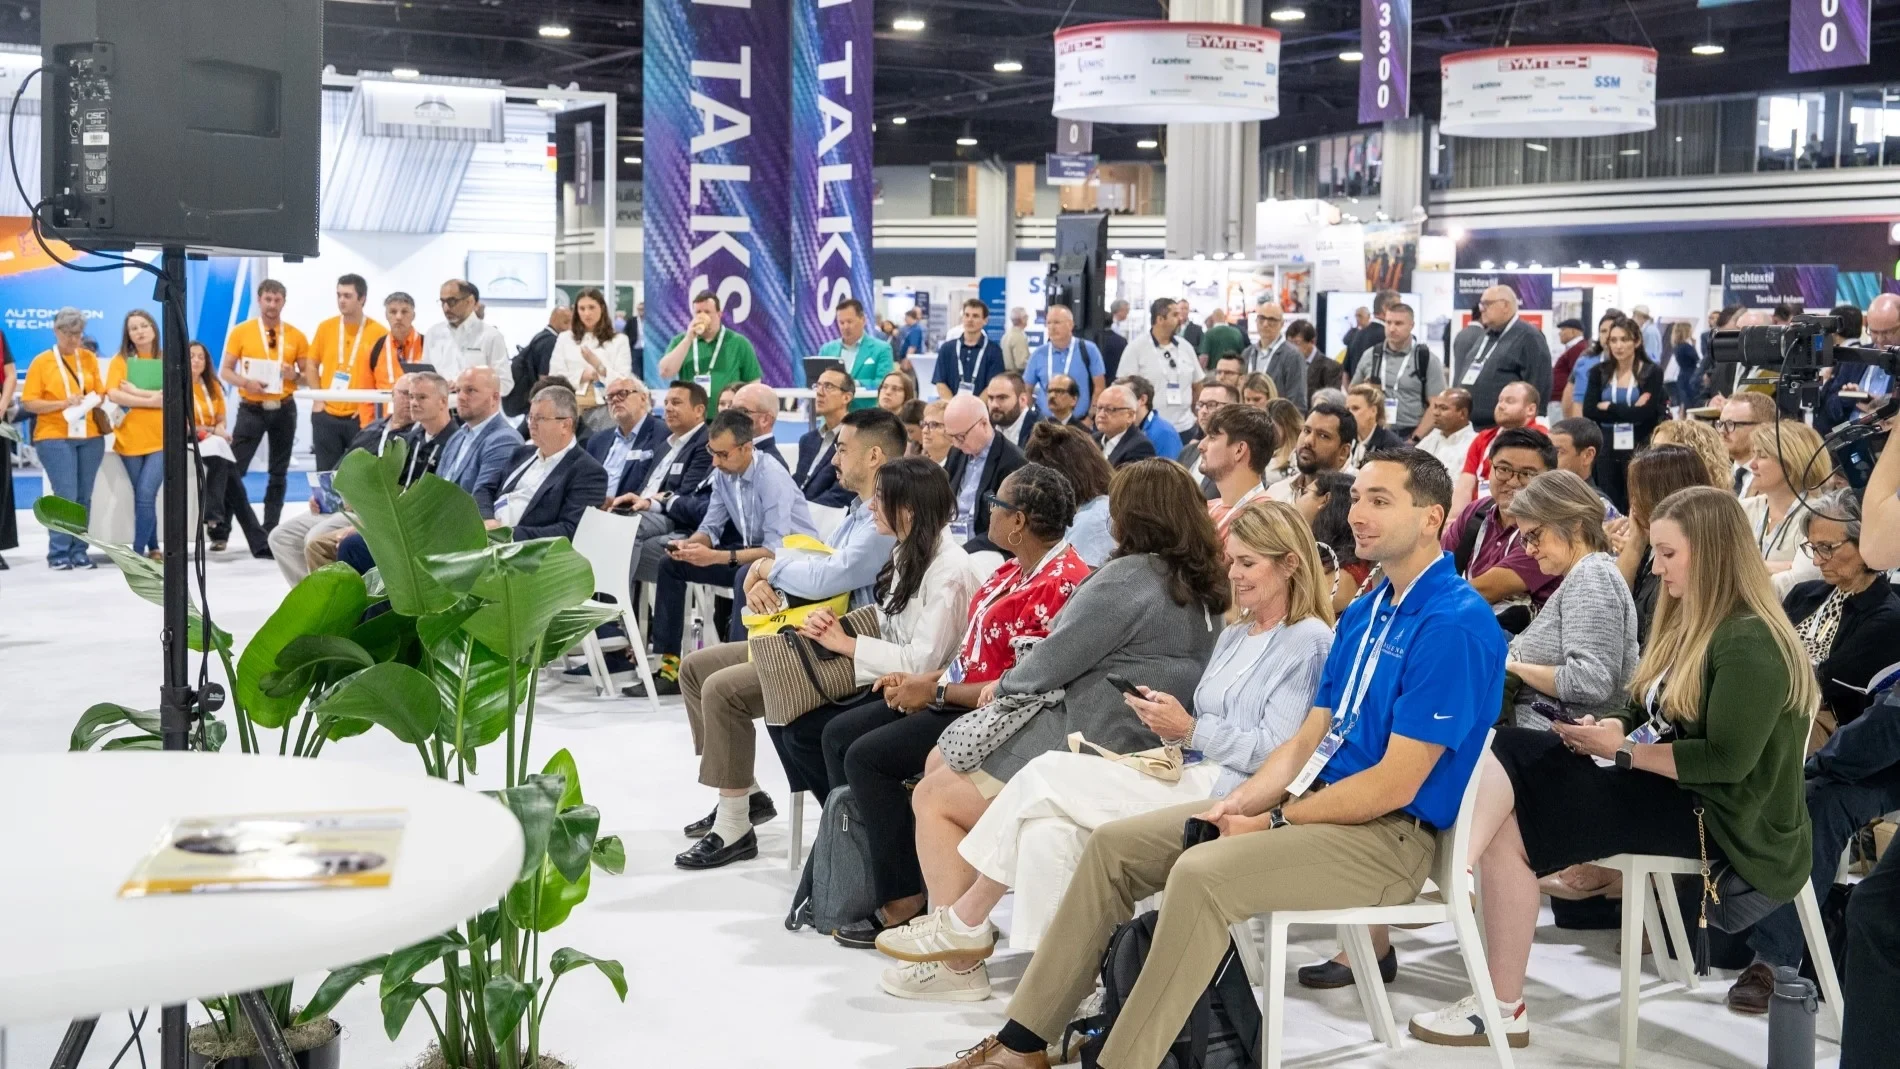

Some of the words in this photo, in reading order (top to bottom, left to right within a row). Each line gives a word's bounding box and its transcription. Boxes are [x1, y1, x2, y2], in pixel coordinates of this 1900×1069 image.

[1187, 34, 1264, 53] SYMTECH
[1377, 2, 1391, 109] 3300
[1498, 56, 1589, 73] SYMTECH
[1594, 75, 1621, 89] SSM
[86, 112, 106, 120] QSC
[690, 46, 751, 324] TALKS
[817, 41, 852, 327] TALKS
[1459, 277, 1498, 287] techtextil
[1731, 271, 1774, 284] techtextil
[1029, 277, 1047, 294] S
[1755, 294, 1782, 304] Tarikul
[1783, 294, 1805, 304] Islam
[5, 308, 104, 320] AUTOMON
[5, 319, 55, 330] TECH
